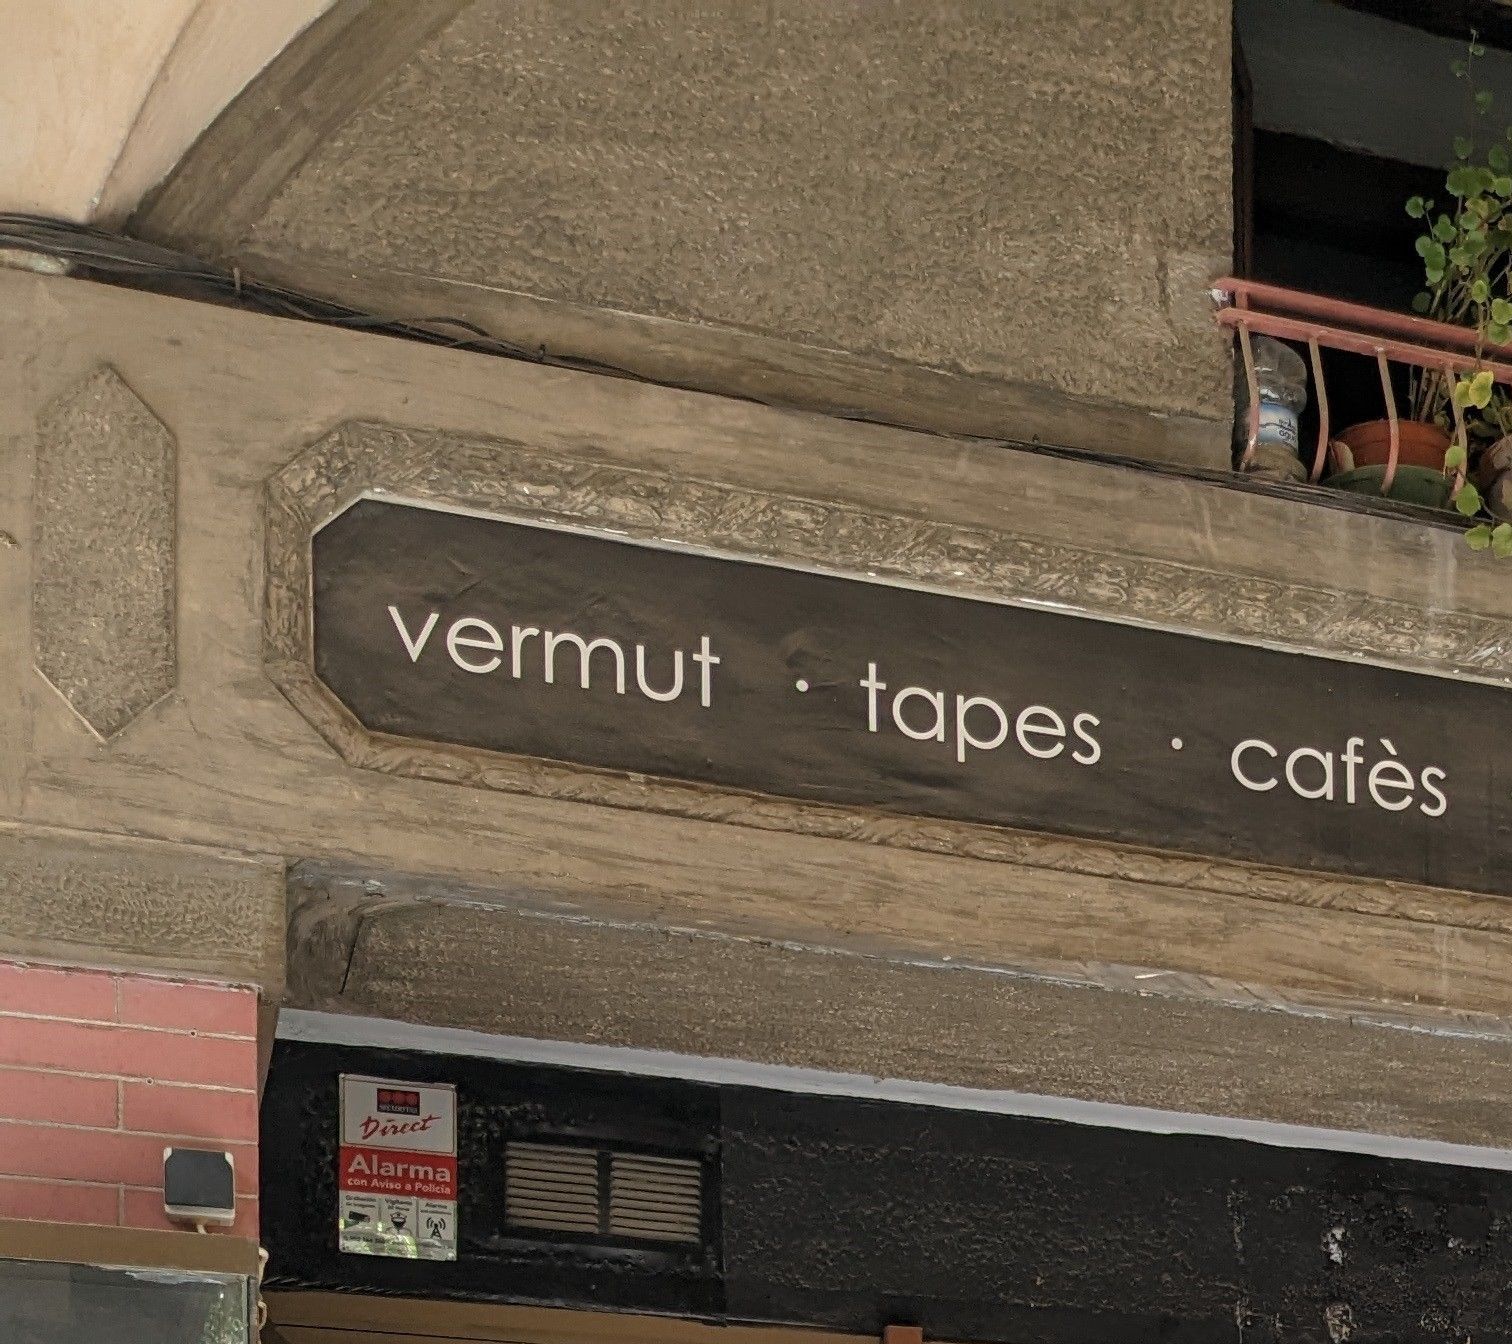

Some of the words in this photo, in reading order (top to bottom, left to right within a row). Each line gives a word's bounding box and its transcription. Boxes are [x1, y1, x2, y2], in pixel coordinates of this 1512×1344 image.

[387, 605, 720, 708] vermut
[859, 662, 1101, 765] tapes
[1230, 736, 1447, 817] cafès
[360, 1114, 442, 1140] Direct
[348, 1153, 451, 1182] Alarma
[347, 1178, 368, 1187] con
[371, 1178, 401, 1190] Aviso
[404, 1183, 412, 1191] a
